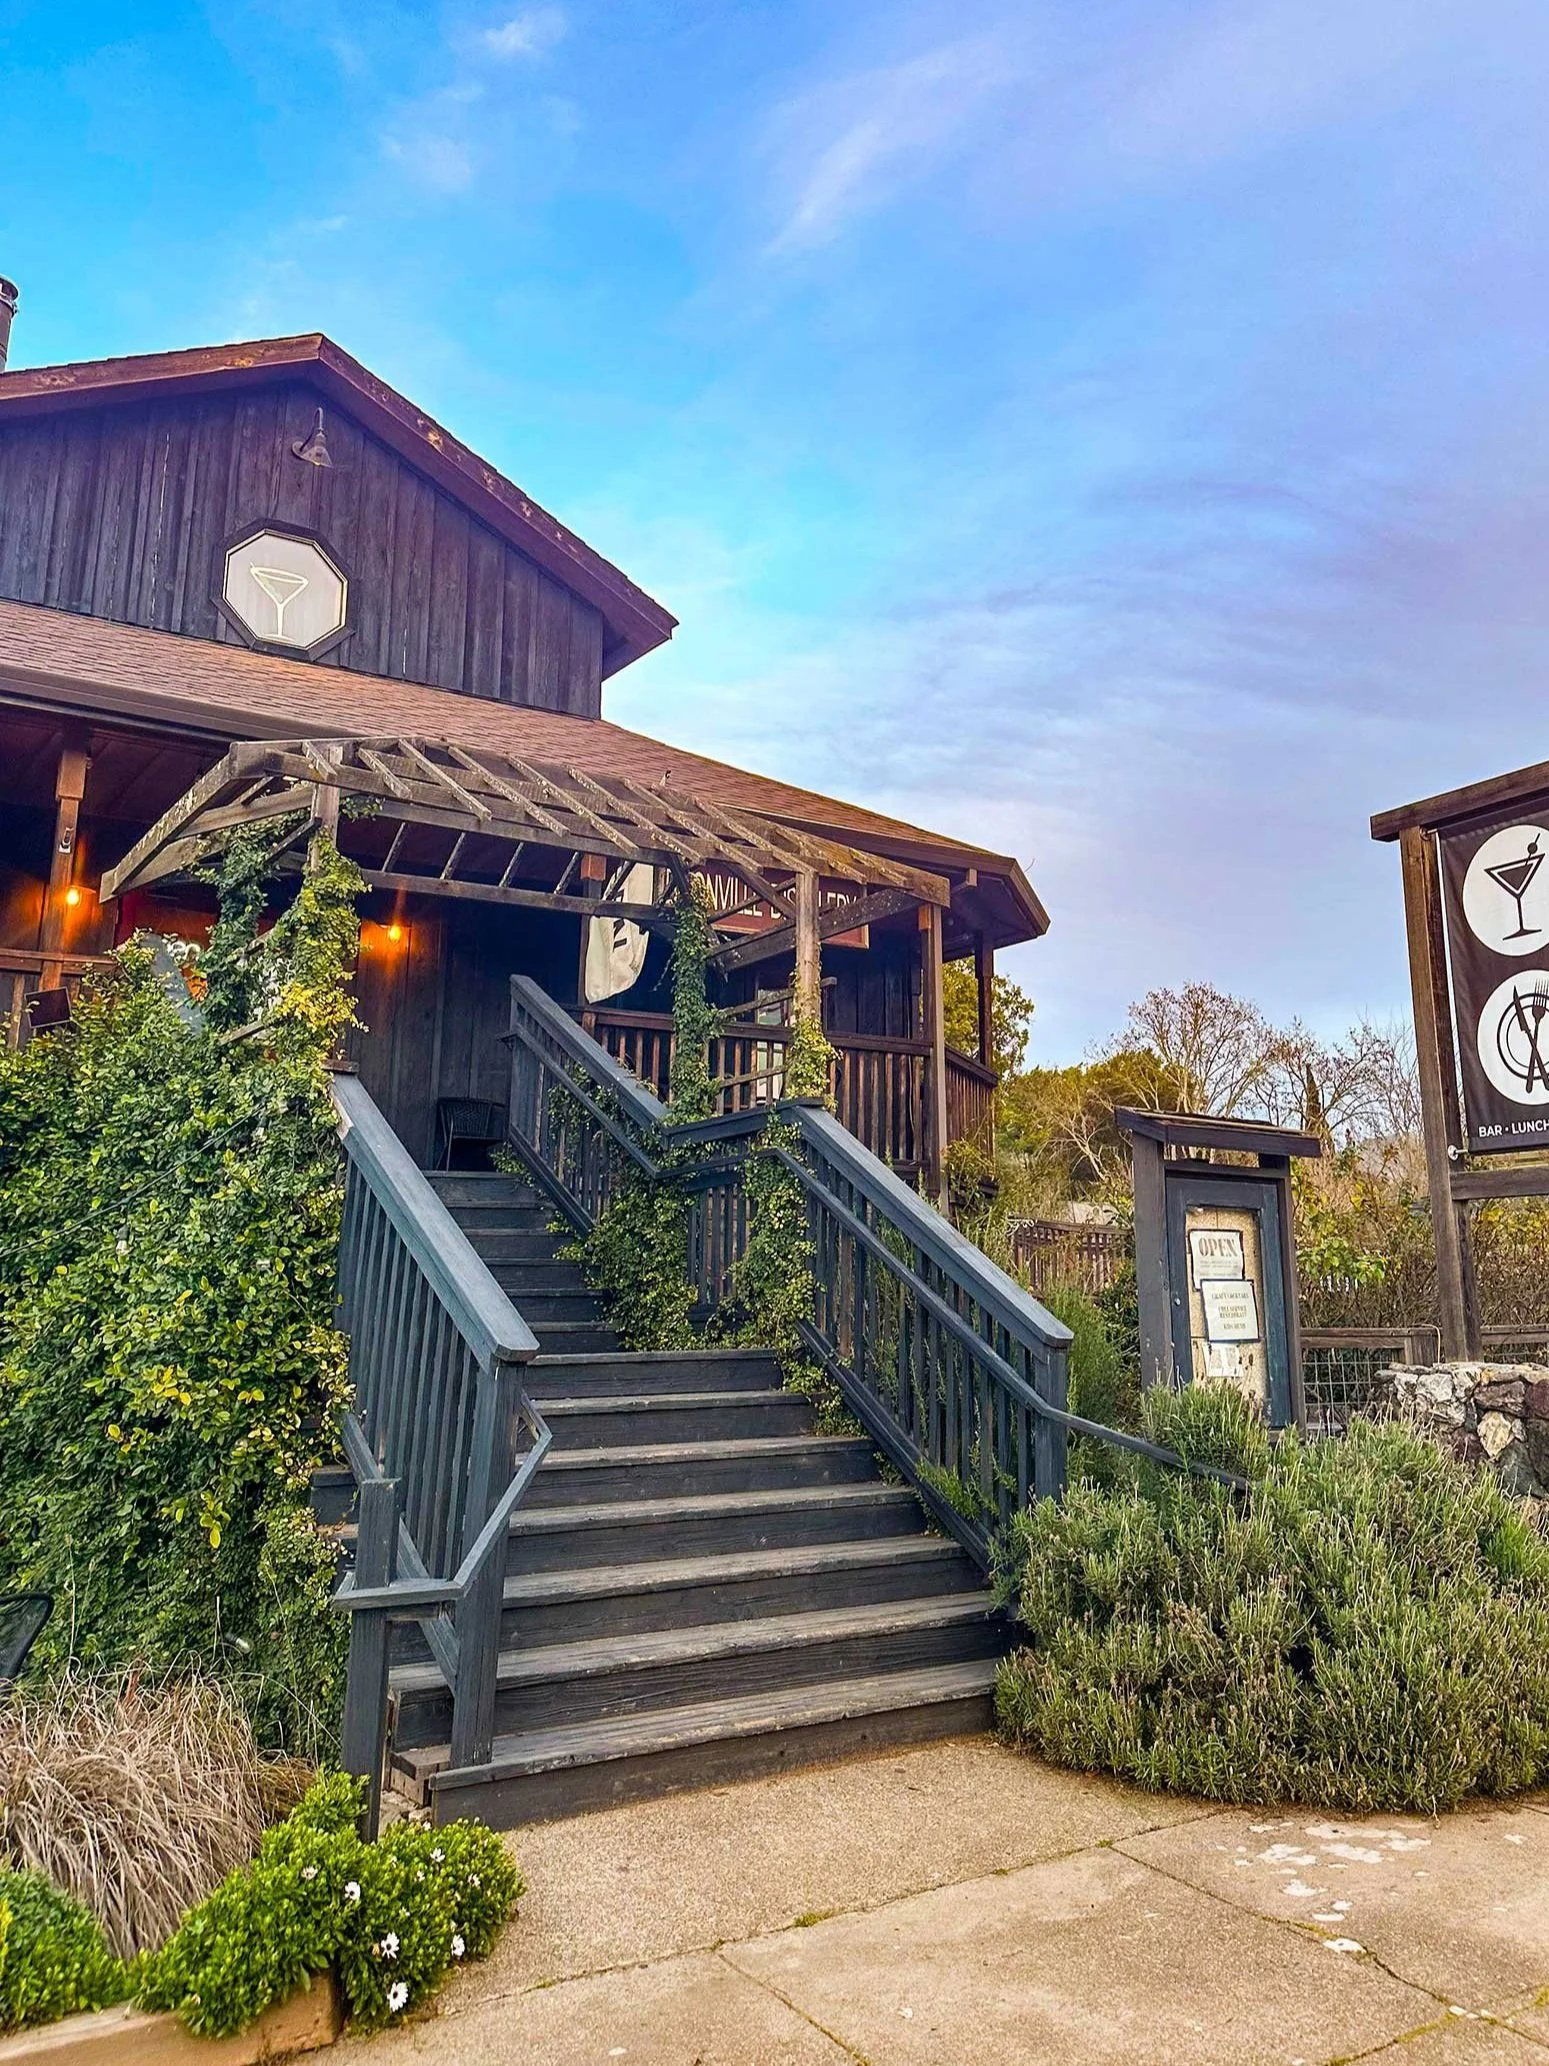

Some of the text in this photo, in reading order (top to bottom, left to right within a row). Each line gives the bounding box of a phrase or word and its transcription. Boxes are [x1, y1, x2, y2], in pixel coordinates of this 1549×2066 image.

[1478, 1119, 1549, 1138] BAR LUNCH
[1198, 1237, 1238, 1257] OPEN
